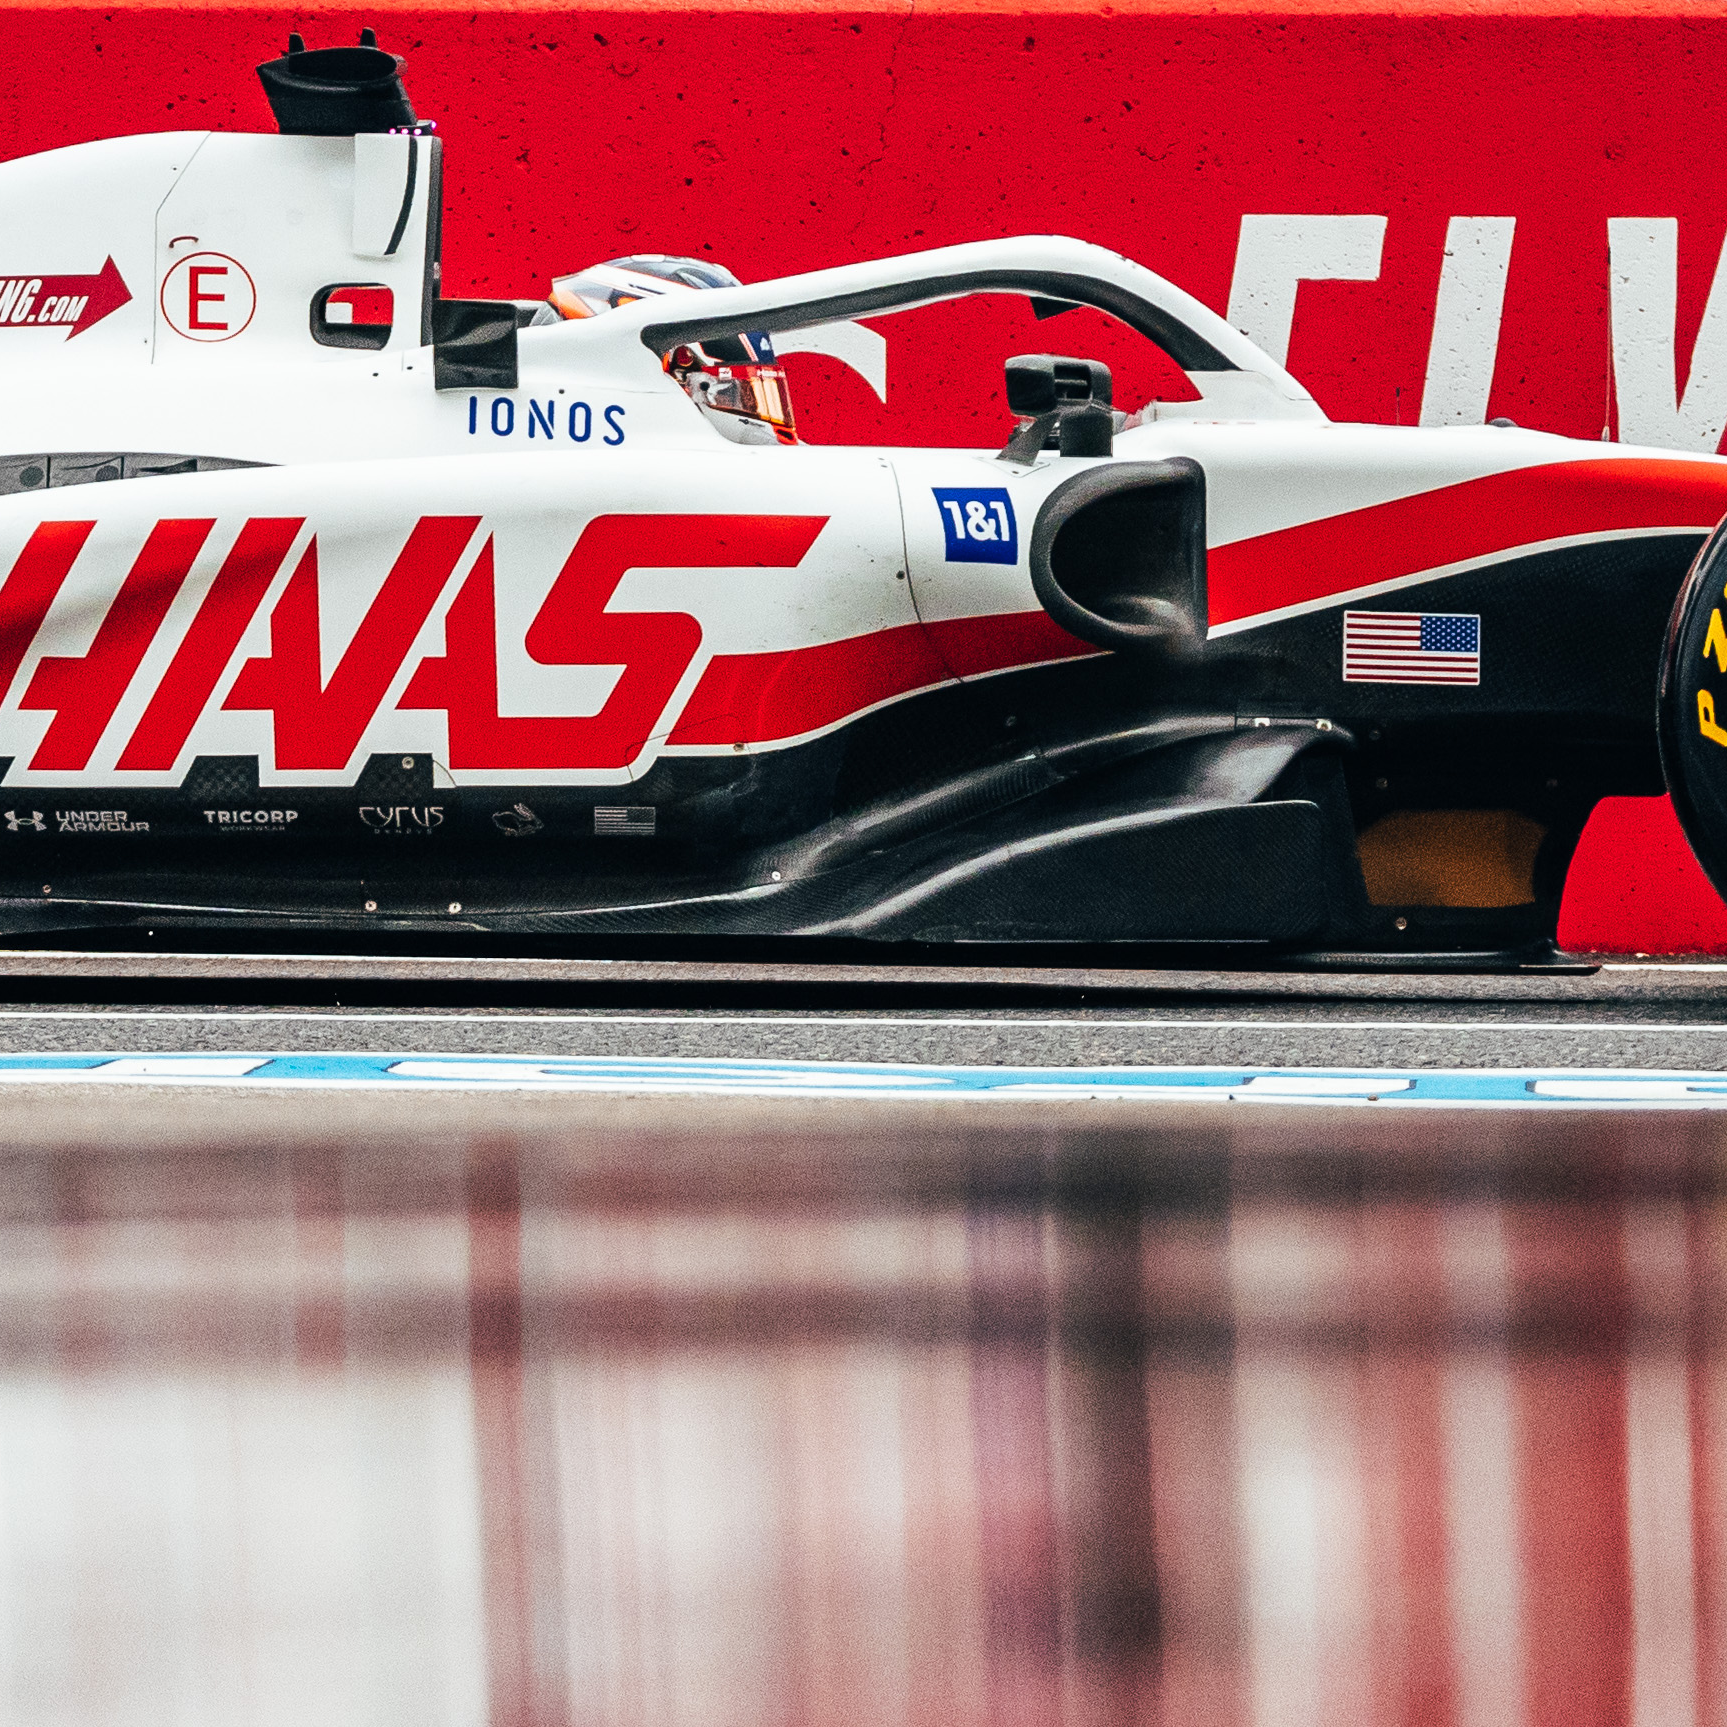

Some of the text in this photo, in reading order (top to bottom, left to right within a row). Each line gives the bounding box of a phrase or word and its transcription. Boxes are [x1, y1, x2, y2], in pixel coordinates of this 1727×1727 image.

[188, 265, 229, 331] E
[468, 395, 626, 446] IONOS
[941, 497, 1016, 544] 1&1
[55, 810, 130, 824] UNDER
[58, 821, 151, 833] ARMOUR
[202, 809, 300, 824] TRICORP
